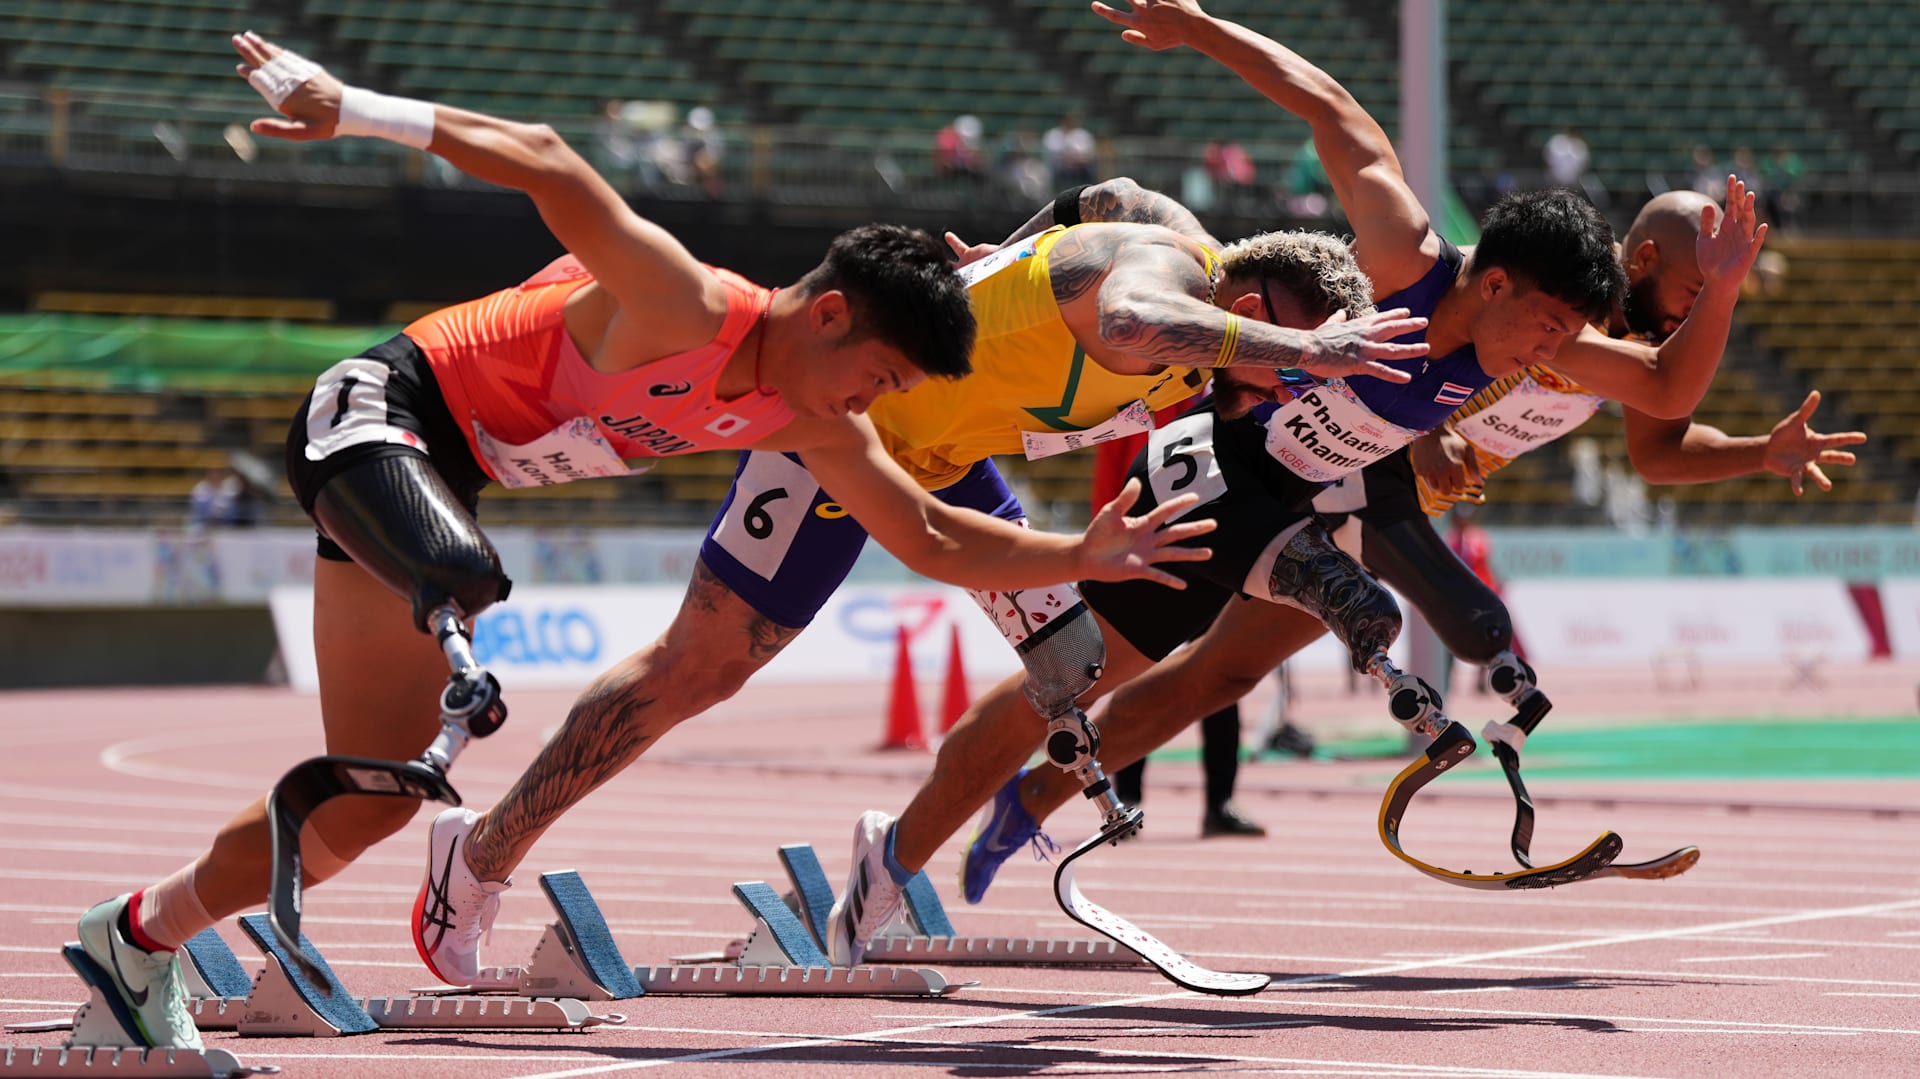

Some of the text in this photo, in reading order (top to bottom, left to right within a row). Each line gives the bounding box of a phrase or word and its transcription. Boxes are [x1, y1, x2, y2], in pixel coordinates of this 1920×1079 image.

[600, 415, 696, 454] JAPAN
[1520, 408, 1564, 428] Leon
[1162, 436, 1198, 491] 5
[1276, 447, 1311, 473] KOBE
[743, 487, 789, 540] 6
